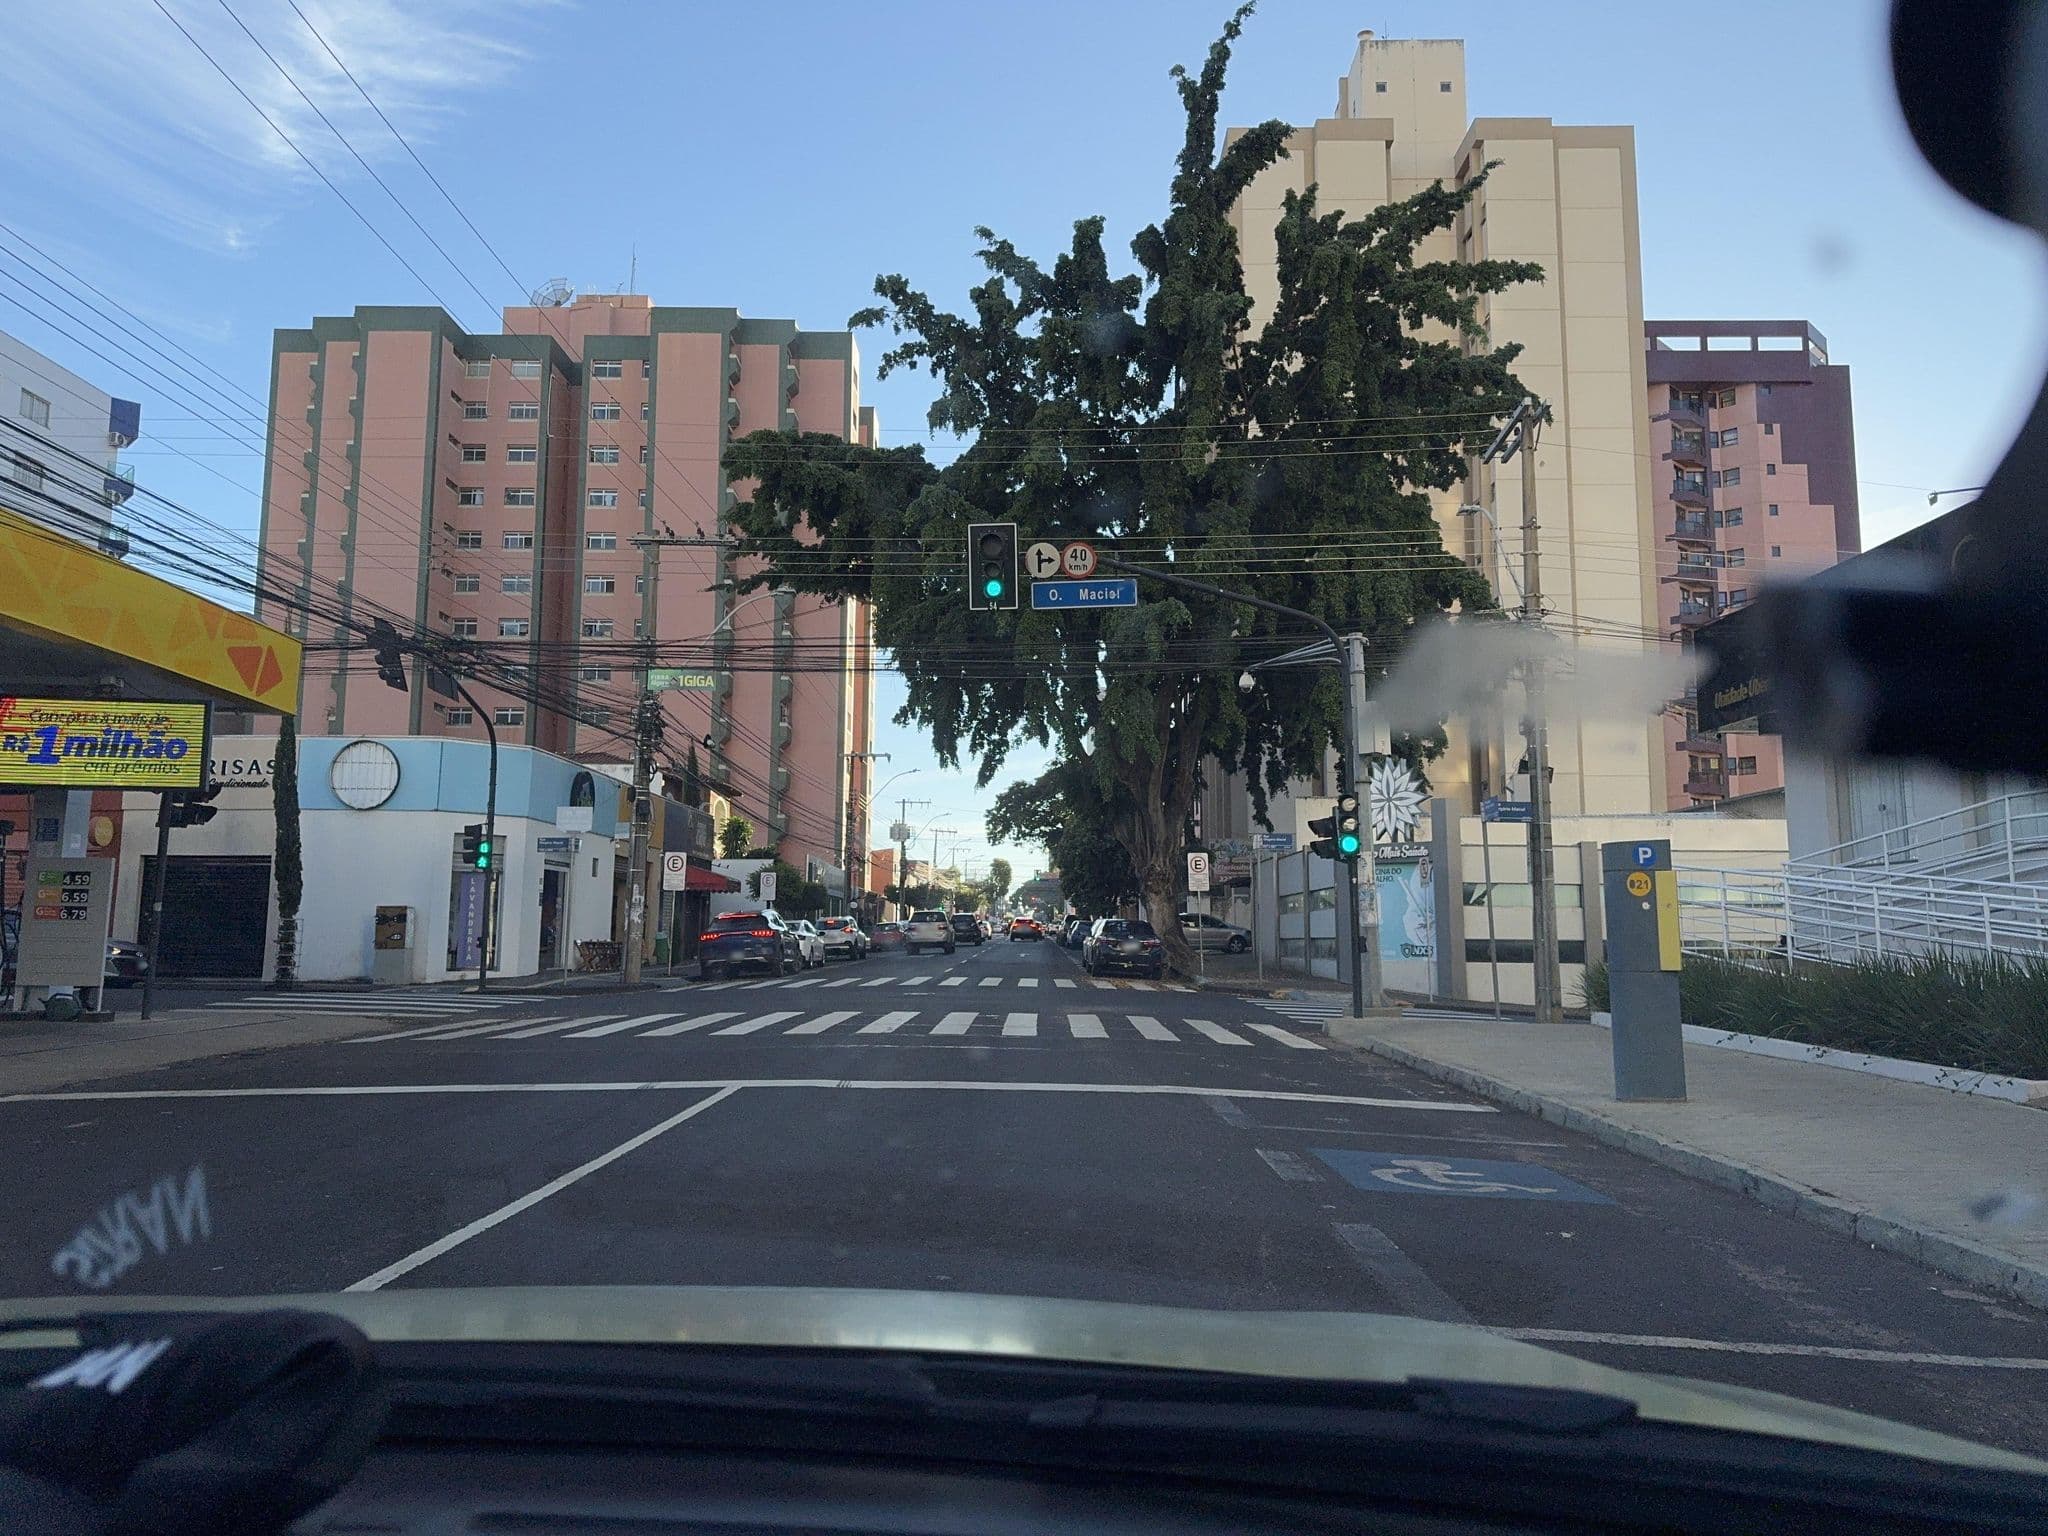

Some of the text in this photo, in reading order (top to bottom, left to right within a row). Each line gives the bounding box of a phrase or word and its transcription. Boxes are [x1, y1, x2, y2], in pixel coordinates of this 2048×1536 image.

[1070, 549, 1087, 562] 40
[1049, 588, 1120, 601] O. Maciel
[27, 725, 61, 765] 1
[63, 727, 189, 760] milhão
[84, 760, 181, 776] em prêmios
[466, 877, 476, 961] LAVANDERIA
